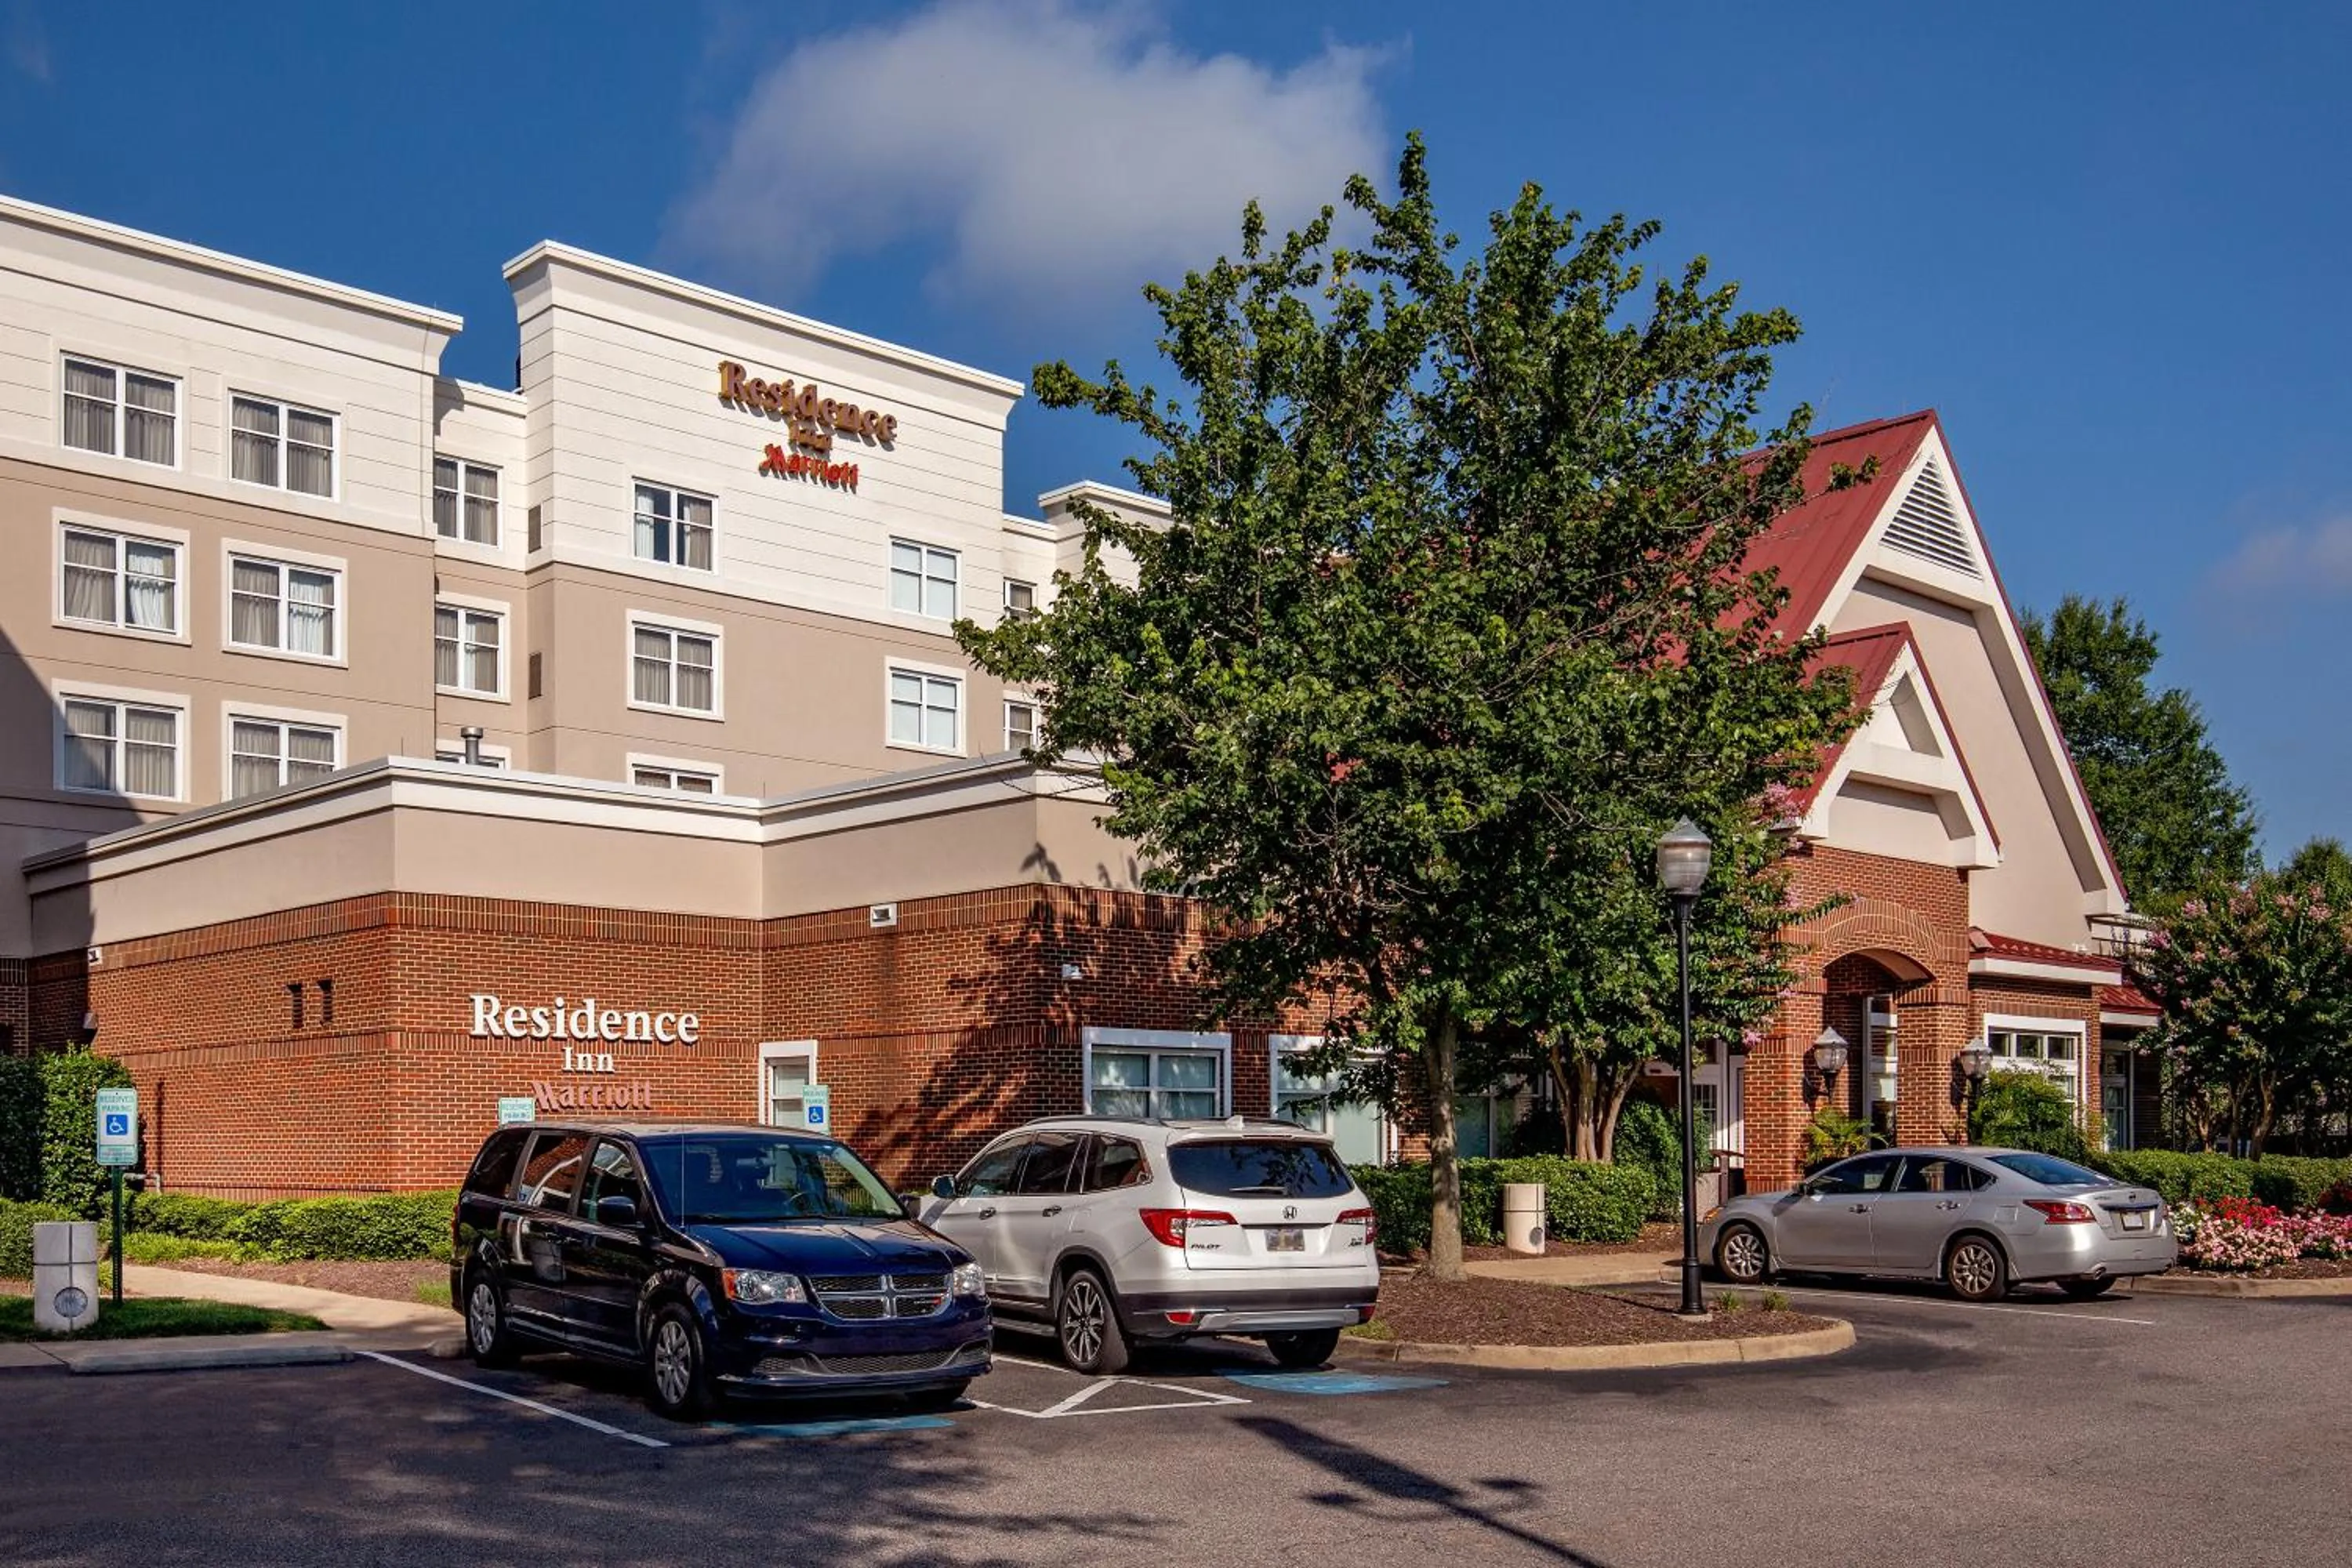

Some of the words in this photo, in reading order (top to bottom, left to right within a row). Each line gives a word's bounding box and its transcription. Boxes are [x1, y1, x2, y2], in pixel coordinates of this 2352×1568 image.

[718, 361, 898, 442] Residence
[788, 419, 833, 452] Inn
[759, 443, 858, 486] Marriott
[470, 994, 699, 1044] Residence
[562, 1047, 615, 1073] Inn
[531, 1080, 653, 1112] Marriott
